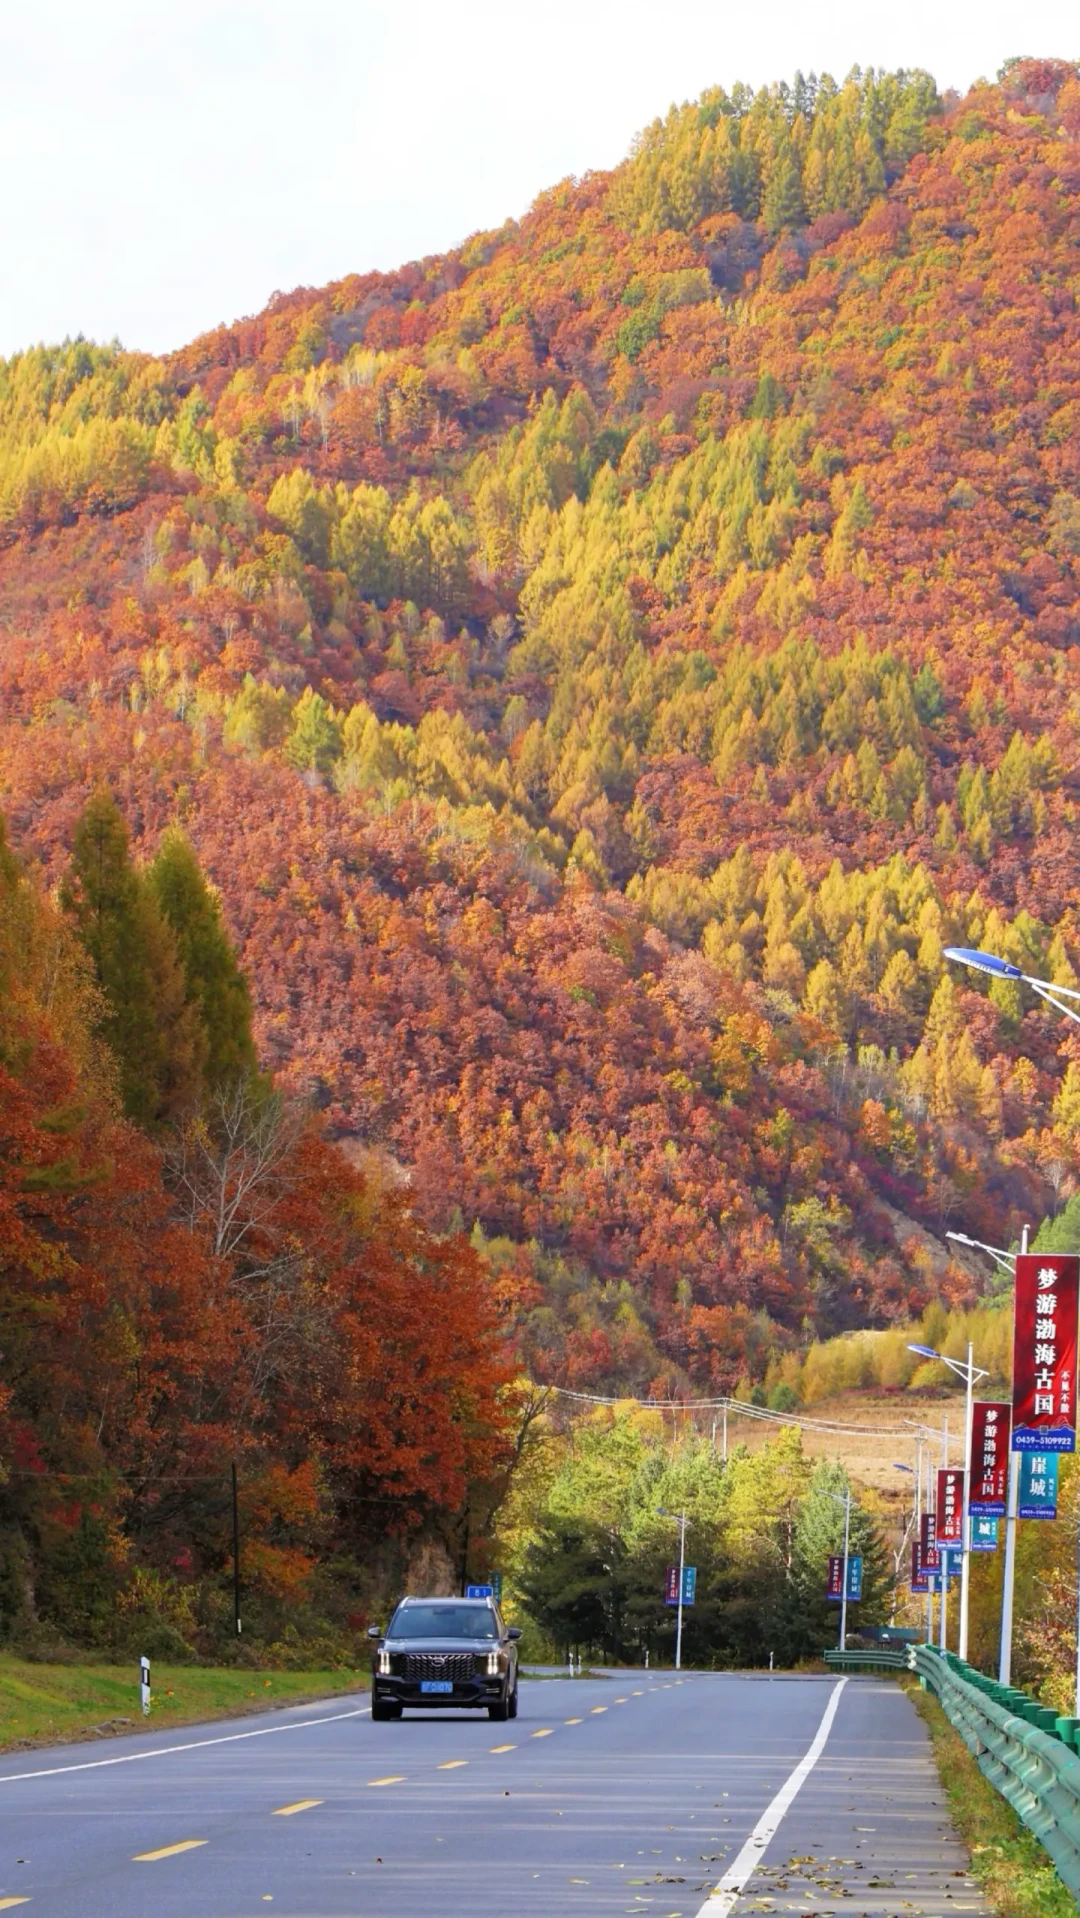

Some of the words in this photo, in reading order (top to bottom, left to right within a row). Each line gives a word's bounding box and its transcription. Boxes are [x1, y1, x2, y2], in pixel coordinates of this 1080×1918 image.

[1034, 1268, 1058, 1415] 梦游渤海古国
[982, 1410, 998, 1496] 梦游渤海古国
